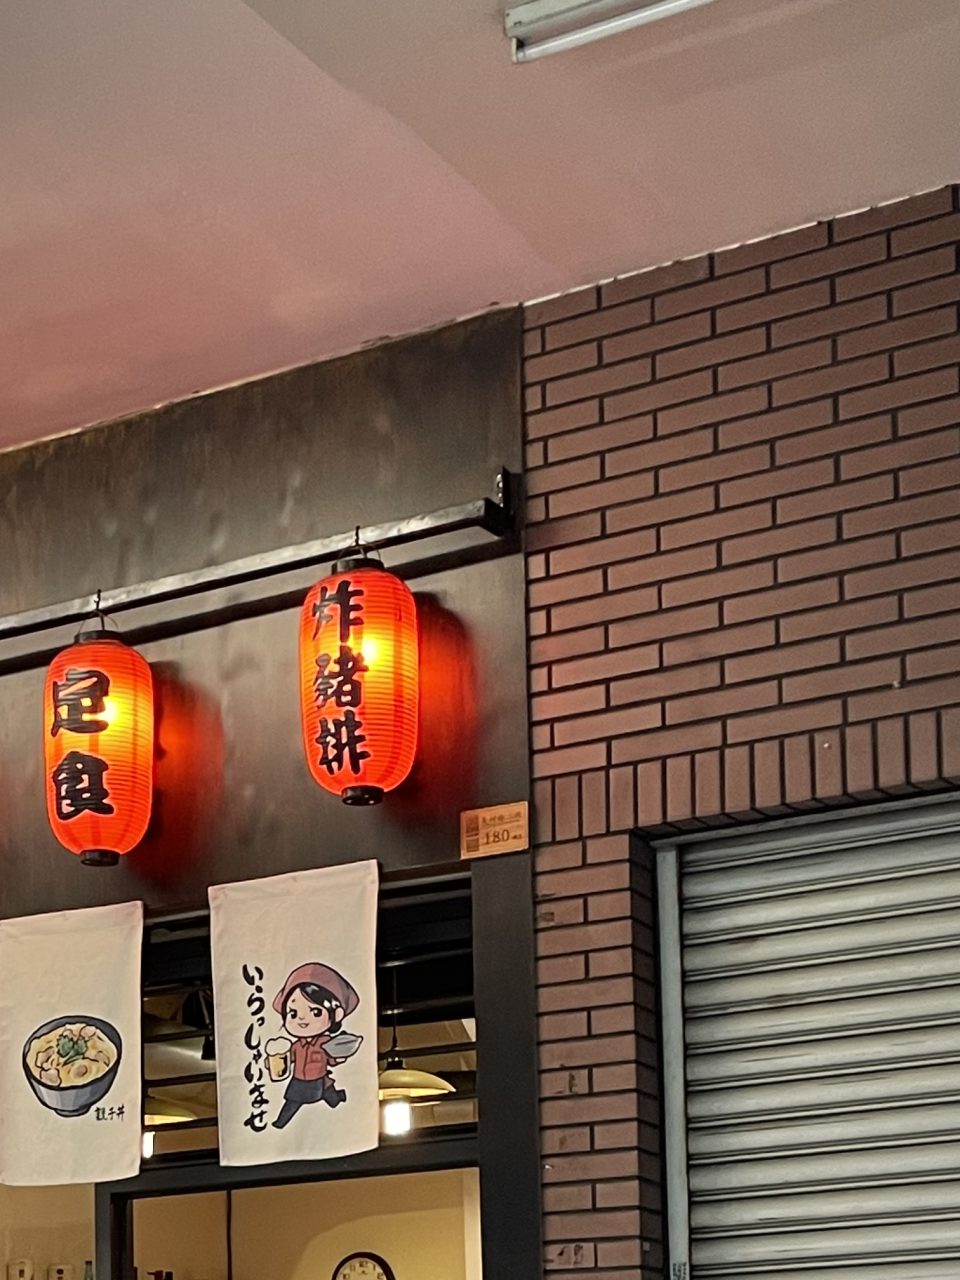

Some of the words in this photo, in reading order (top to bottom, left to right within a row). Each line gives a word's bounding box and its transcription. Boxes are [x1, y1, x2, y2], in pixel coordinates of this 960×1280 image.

[51, 669, 114, 821] 定食
[312, 580, 370, 775] 炸豬排
[242, 962, 269, 1133] いらっしゃいませ
